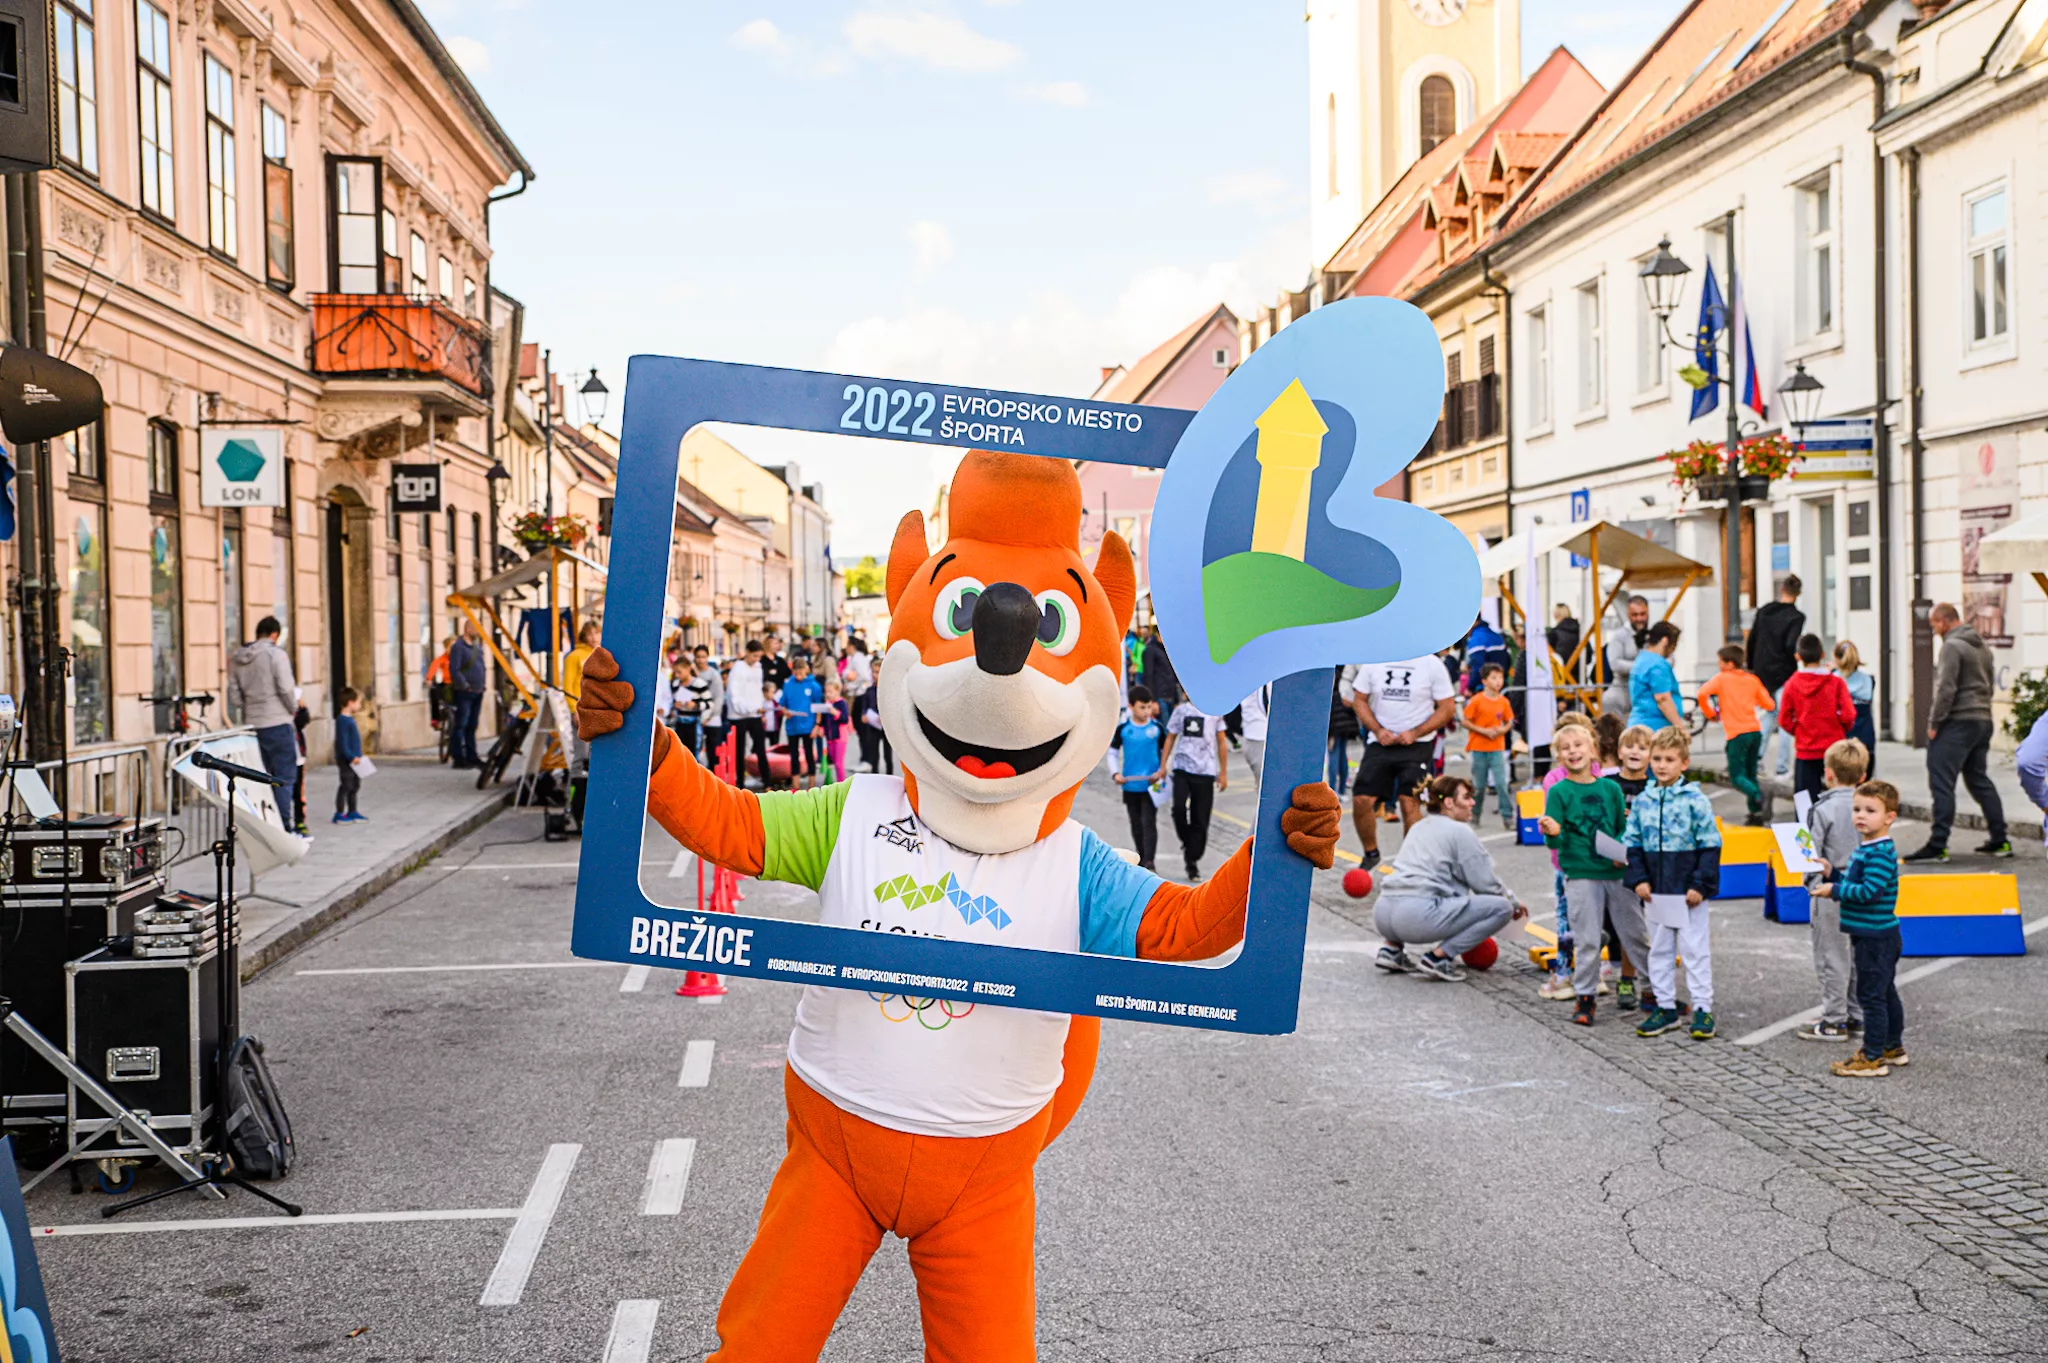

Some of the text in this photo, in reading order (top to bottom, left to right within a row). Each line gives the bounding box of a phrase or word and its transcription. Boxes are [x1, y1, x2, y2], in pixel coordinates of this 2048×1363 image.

[840, 384, 1144, 437] 2022 EVROPSKO MESTO
[939, 417, 1026, 447] ŠPORTA
[222, 487, 262, 501] LON
[873, 823, 924, 855] PEAK
[629, 915, 1016, 997] BREŽICE #OBCINABREZICE #EVROPSKOMESTOSPORTA2022 #ETS2022
[1095, 994, 1238, 1022] MESTO ŠPORTA ZA VSE GENERACIJE
